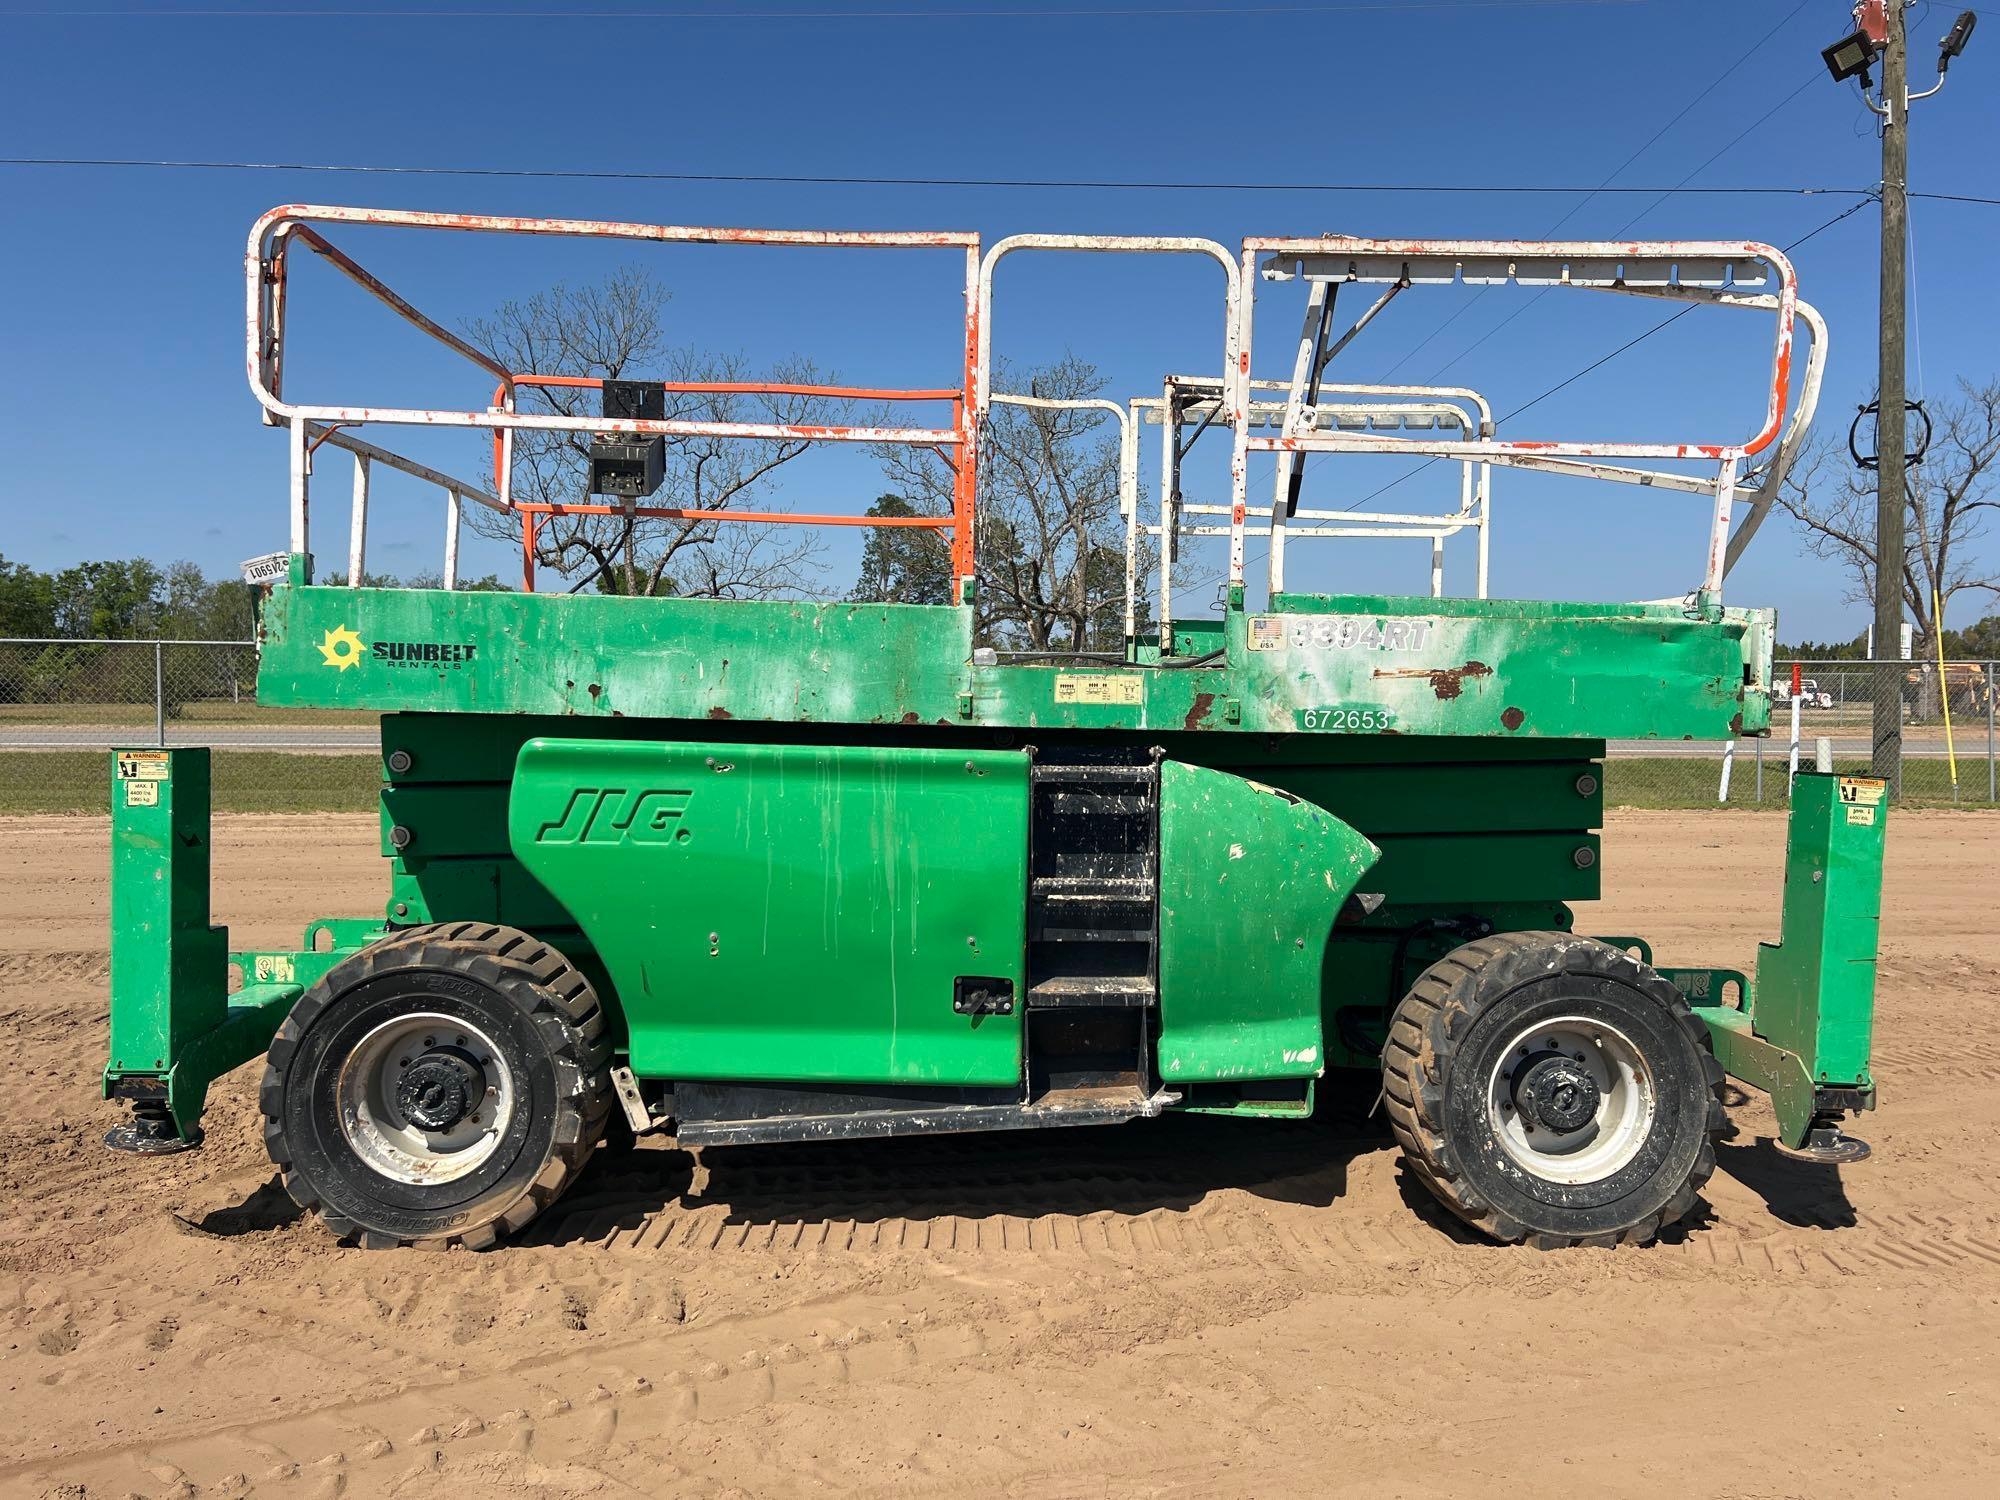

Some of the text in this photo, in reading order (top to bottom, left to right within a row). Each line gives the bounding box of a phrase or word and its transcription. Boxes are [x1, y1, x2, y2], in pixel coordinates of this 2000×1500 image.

[1289, 618, 1433, 652] 3394RT
[372, 641, 477, 662] SUNBELT
[387, 661, 462, 670] RENTALS
[1304, 709, 1389, 729] 672653
